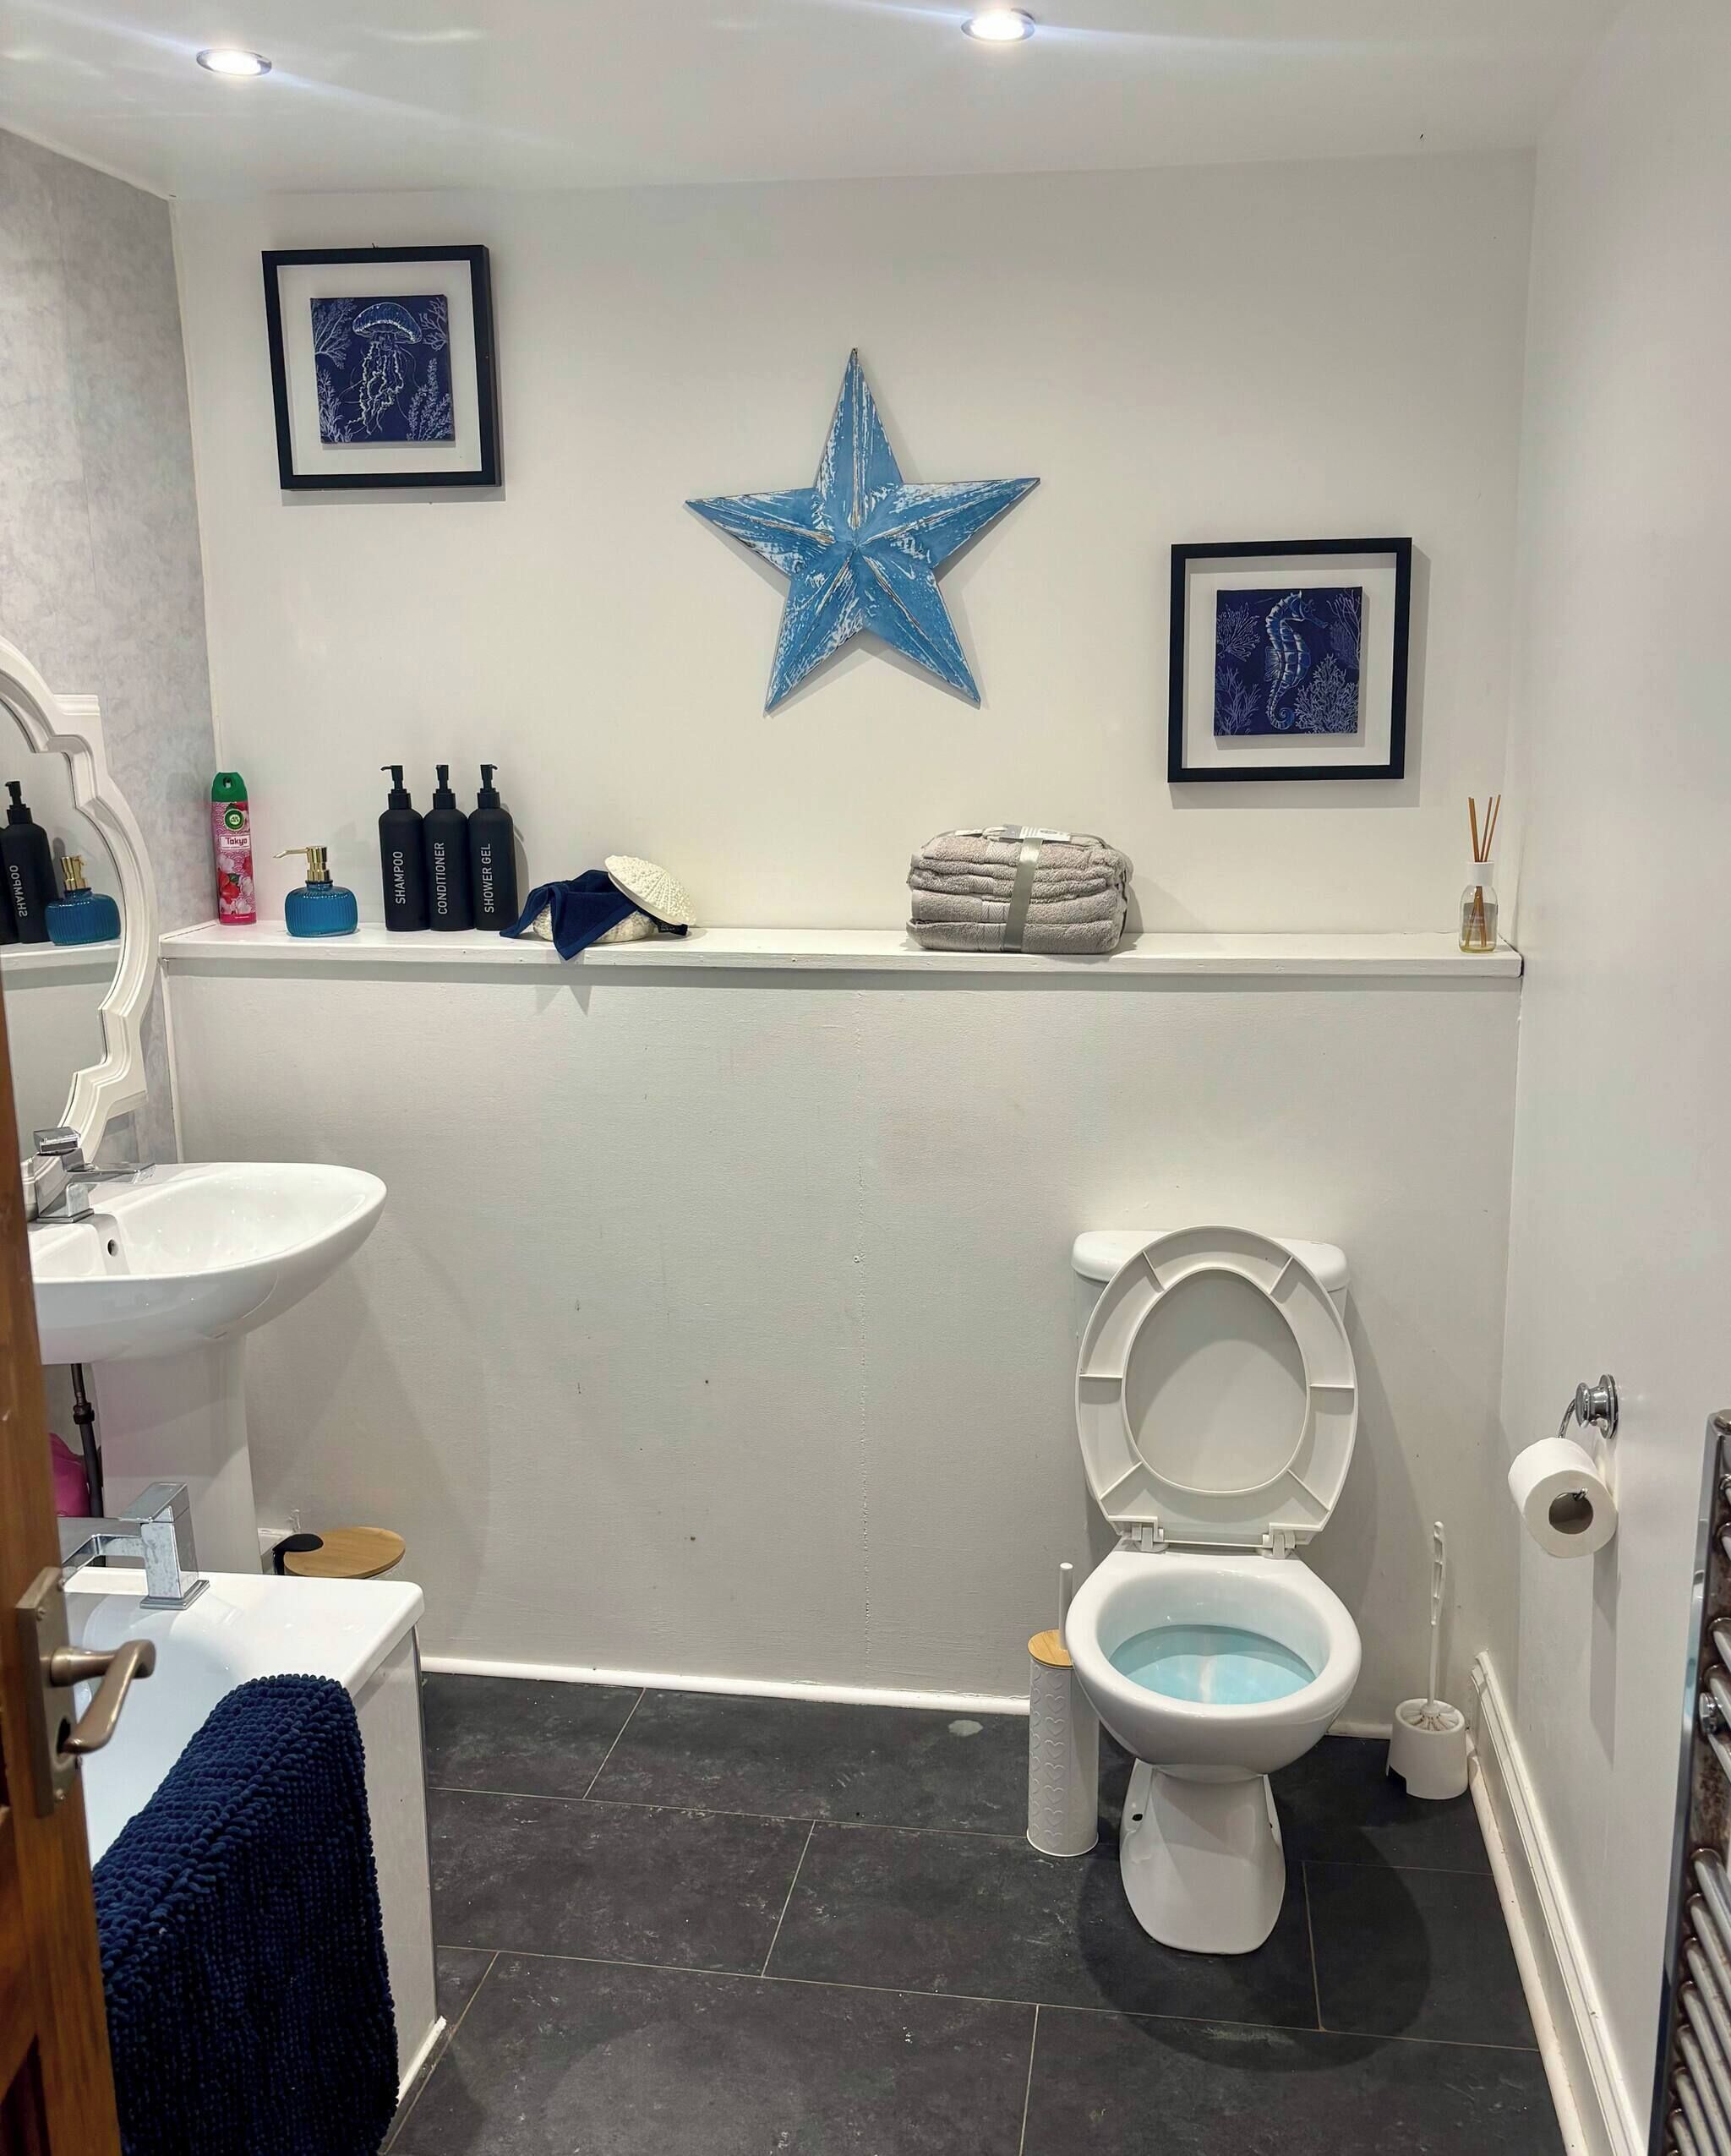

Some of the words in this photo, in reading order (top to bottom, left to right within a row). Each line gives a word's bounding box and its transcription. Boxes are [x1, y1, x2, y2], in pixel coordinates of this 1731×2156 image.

[392, 851, 406, 904] SHAMPOO
[434, 842, 448, 914] CONDITIONER
[481, 843, 492, 864] GEL
[482, 867, 494, 914] SHOWER
